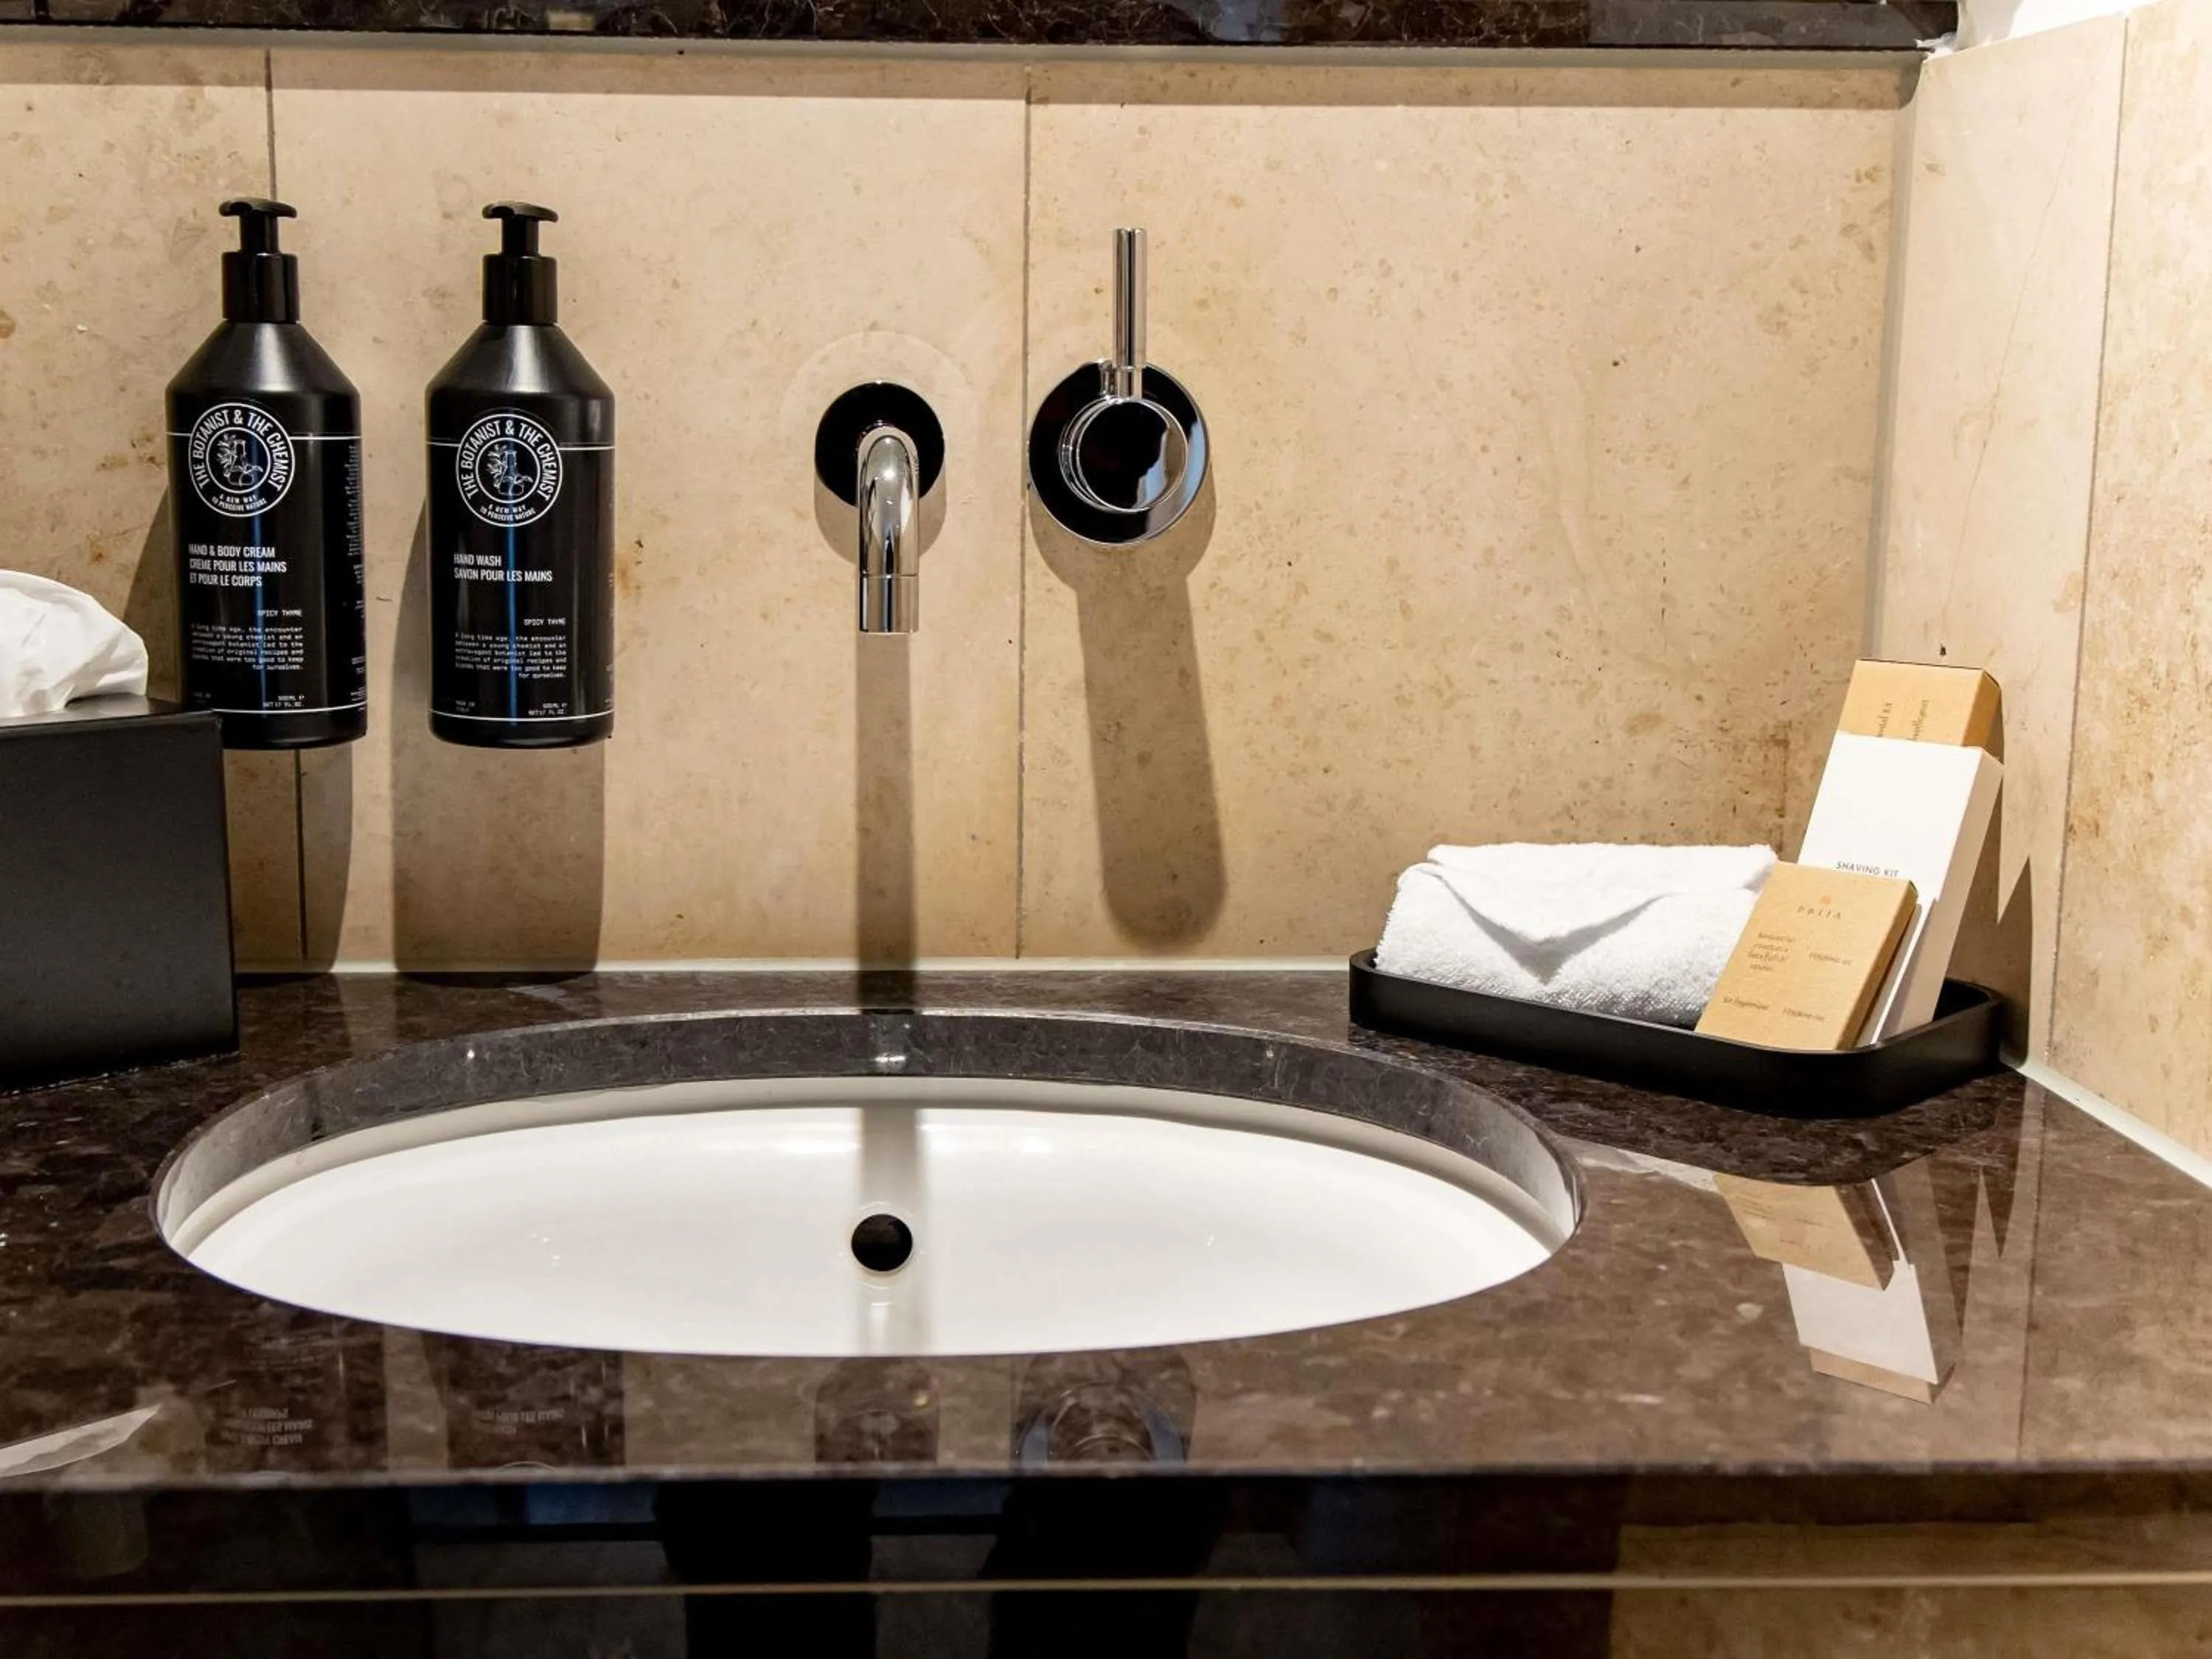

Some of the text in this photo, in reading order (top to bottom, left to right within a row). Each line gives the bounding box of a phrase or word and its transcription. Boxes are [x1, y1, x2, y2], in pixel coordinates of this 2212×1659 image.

[192, 409, 290, 492] THE BOTANIST & THE CHEMIST
[461, 420, 556, 501] THE BOTANIST & THE CHEMIST
[188, 543, 275, 558] HAND & BODY CREAM
[213, 560, 237, 571] POUR
[239, 561, 254, 572] LES
[257, 562, 287, 573] MAINS
[453, 554, 502, 567] HAND WASH
[189, 572, 262, 587] ET POUR LE CORPS
[453, 568, 553, 582] SAVON POUR LES MAINS
[1834, 860, 1899, 877] SHAVING KIT
